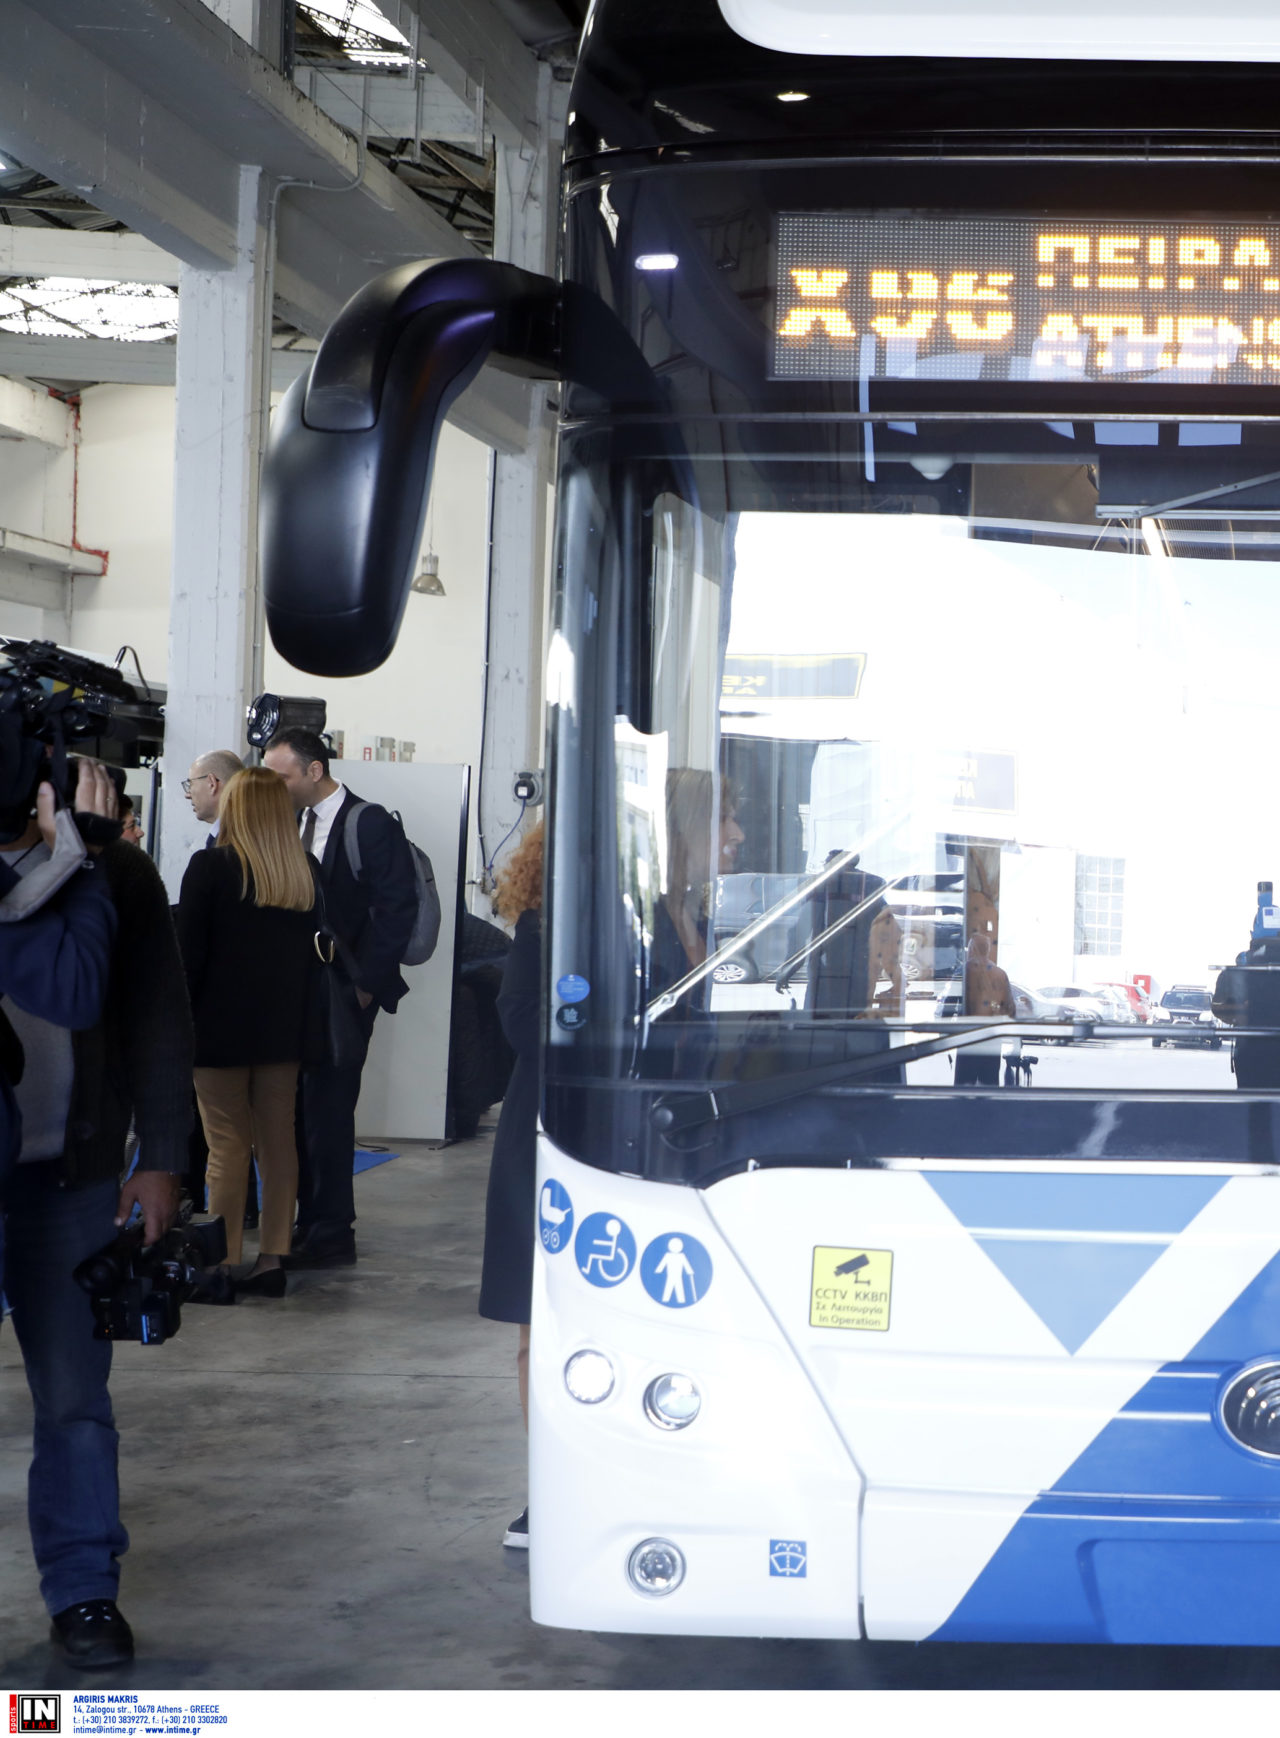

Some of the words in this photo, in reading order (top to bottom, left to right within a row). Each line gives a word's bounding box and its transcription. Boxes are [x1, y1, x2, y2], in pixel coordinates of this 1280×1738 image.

[779, 268, 1015, 341] X96
[815, 1287, 848, 1300] CCTV
[819, 1314, 829, 1323] In
[831, 1315, 881, 1326] Operation
